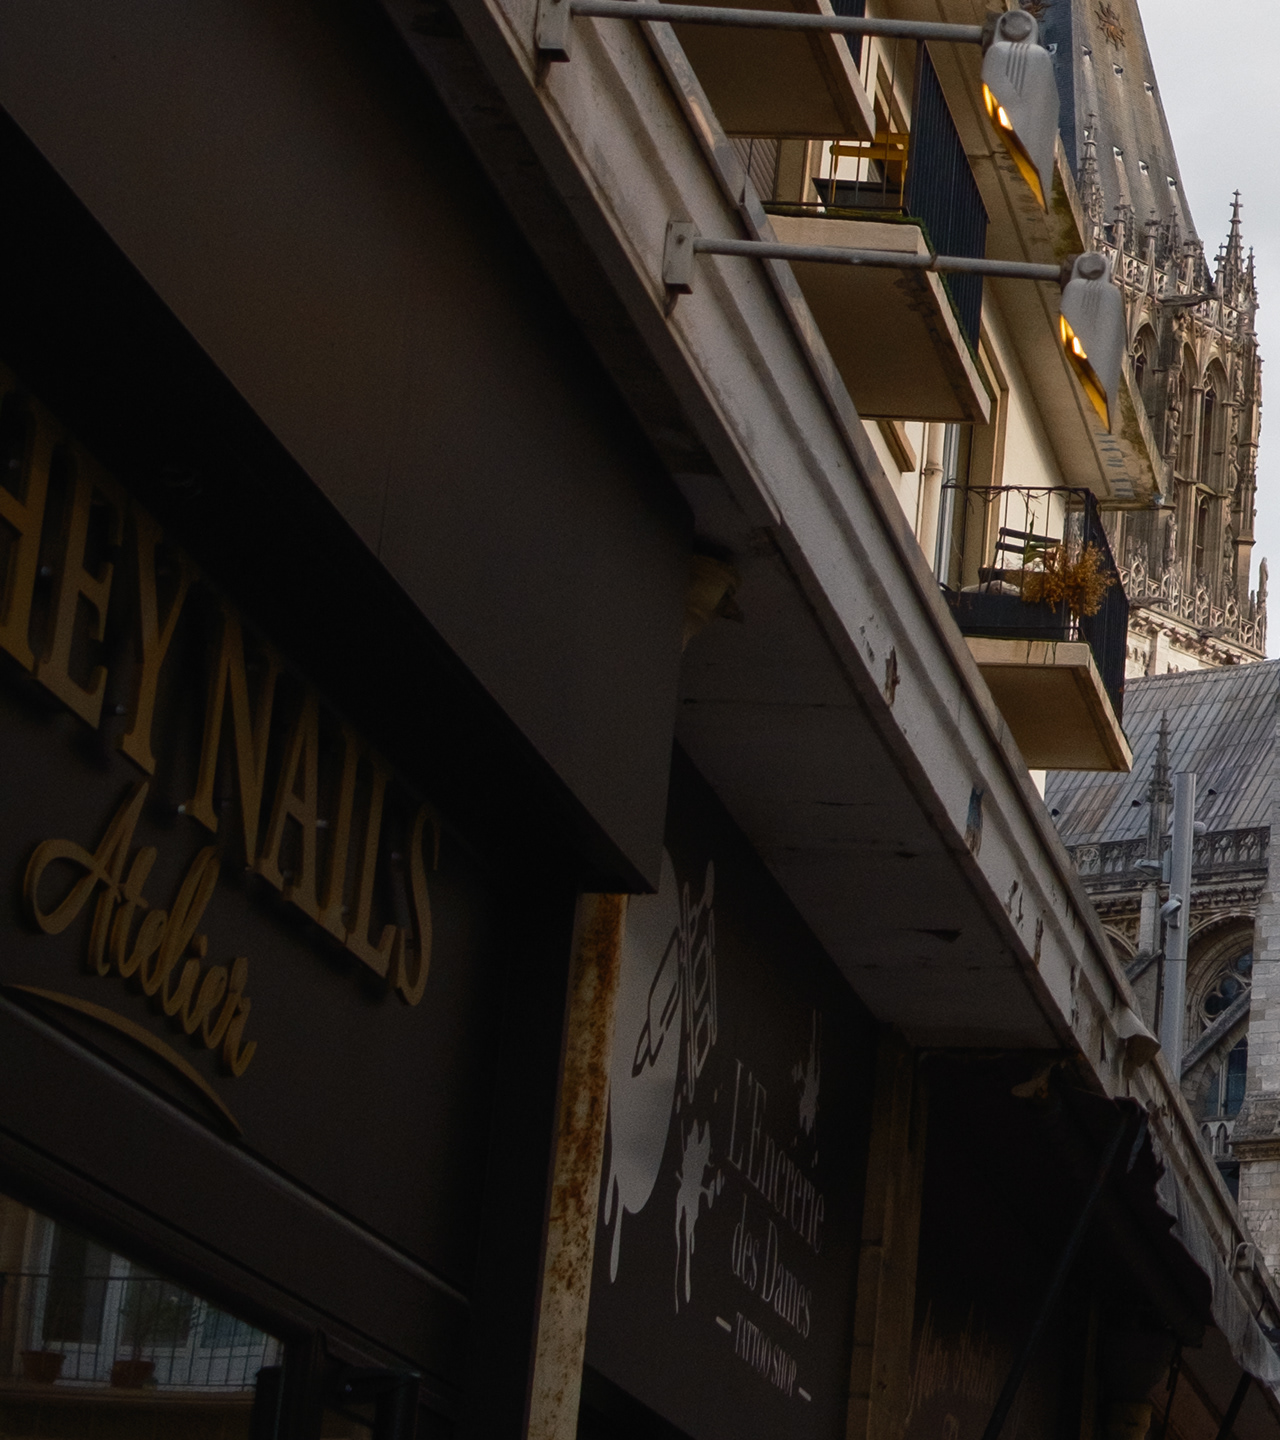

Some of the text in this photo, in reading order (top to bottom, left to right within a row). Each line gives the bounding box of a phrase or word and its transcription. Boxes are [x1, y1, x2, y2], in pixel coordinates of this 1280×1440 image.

[184, 608, 441, 1007] NAILS
[24, 779, 258, 1077] Atelier
[727, 1058, 824, 1253] L'Encrerie
[732, 1193, 812, 1339] des Dames
[735, 1311, 797, 1397] TATTOO SHOP
